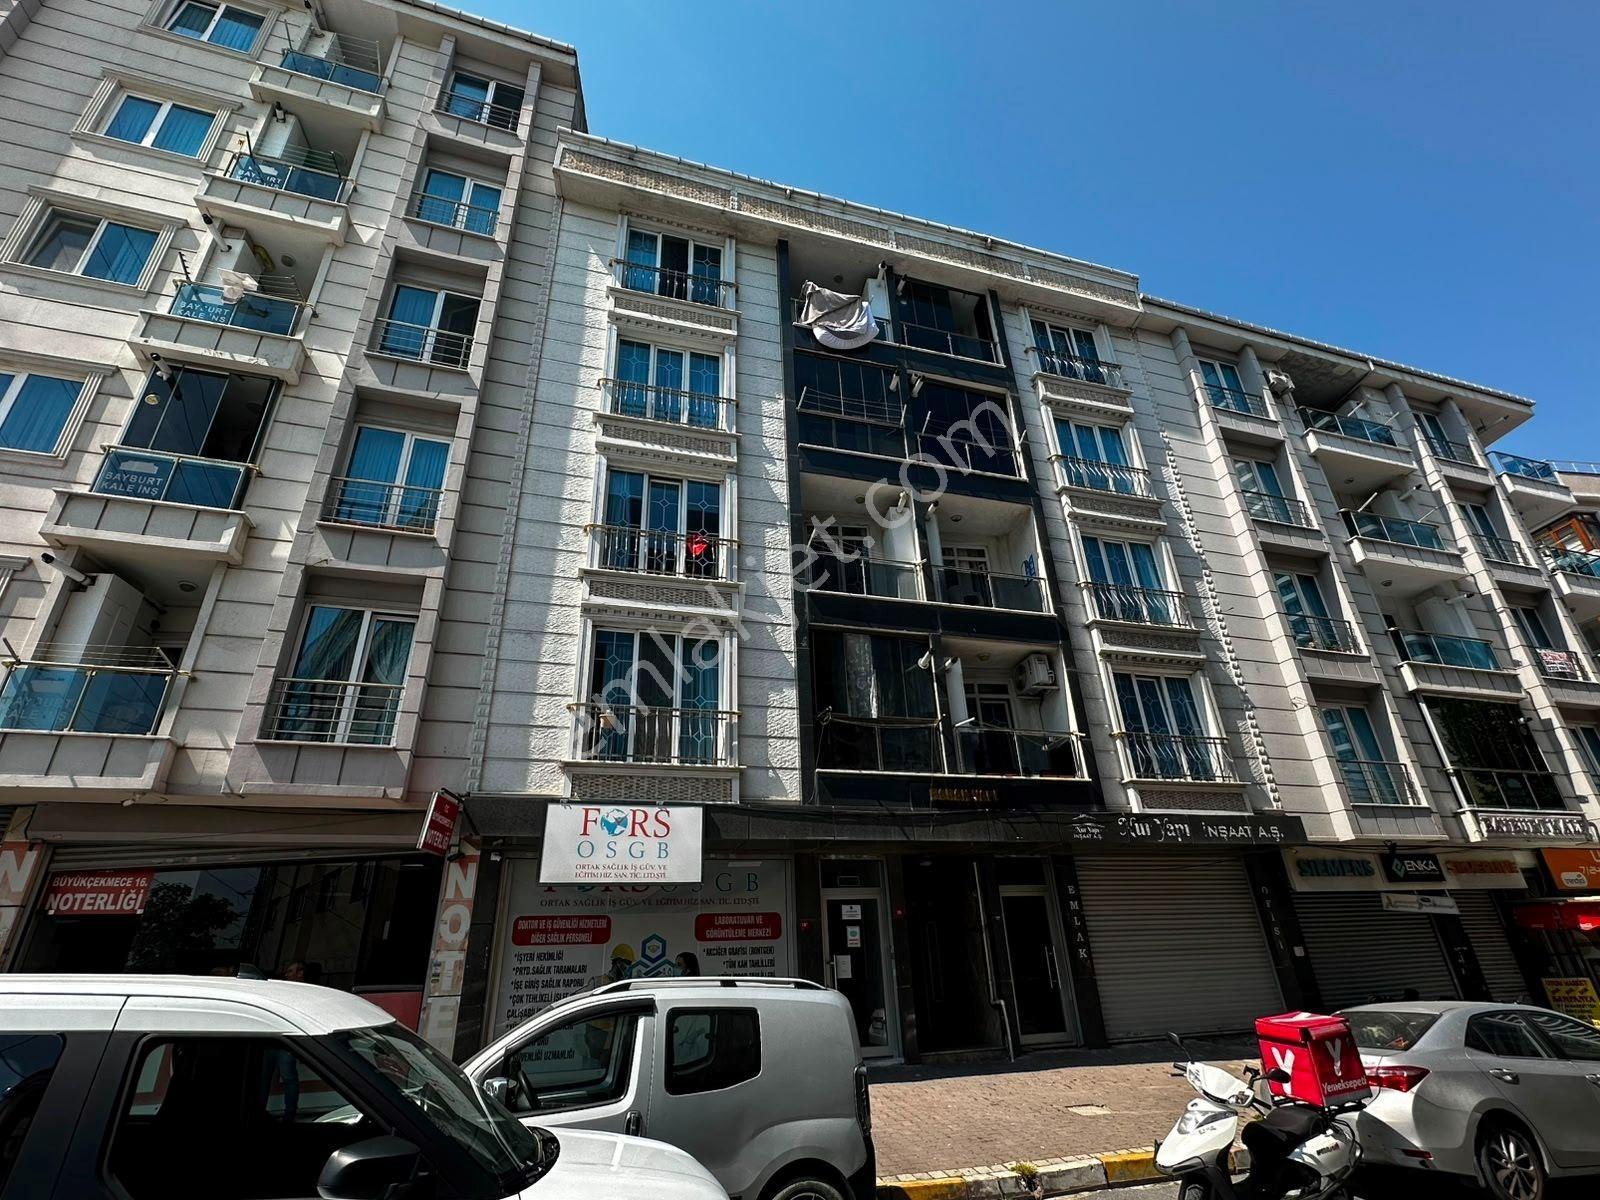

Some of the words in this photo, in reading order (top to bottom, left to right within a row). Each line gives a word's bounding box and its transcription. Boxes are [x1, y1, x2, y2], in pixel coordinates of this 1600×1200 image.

[101, 481, 135, 492] KALE
[577, 840, 669, 860] OSGB
[602, 861, 628, 871] SAĞLIK
[1404, 860, 1438, 871] ENKA
[53, 875, 134, 889] BÜYÜKÇEKMECE
[135, 877, 148, 887] 16.
[45, 889, 144, 911] NOTERLİĞİ
[1322, 1076, 1367, 1095] Yemeksepeti
